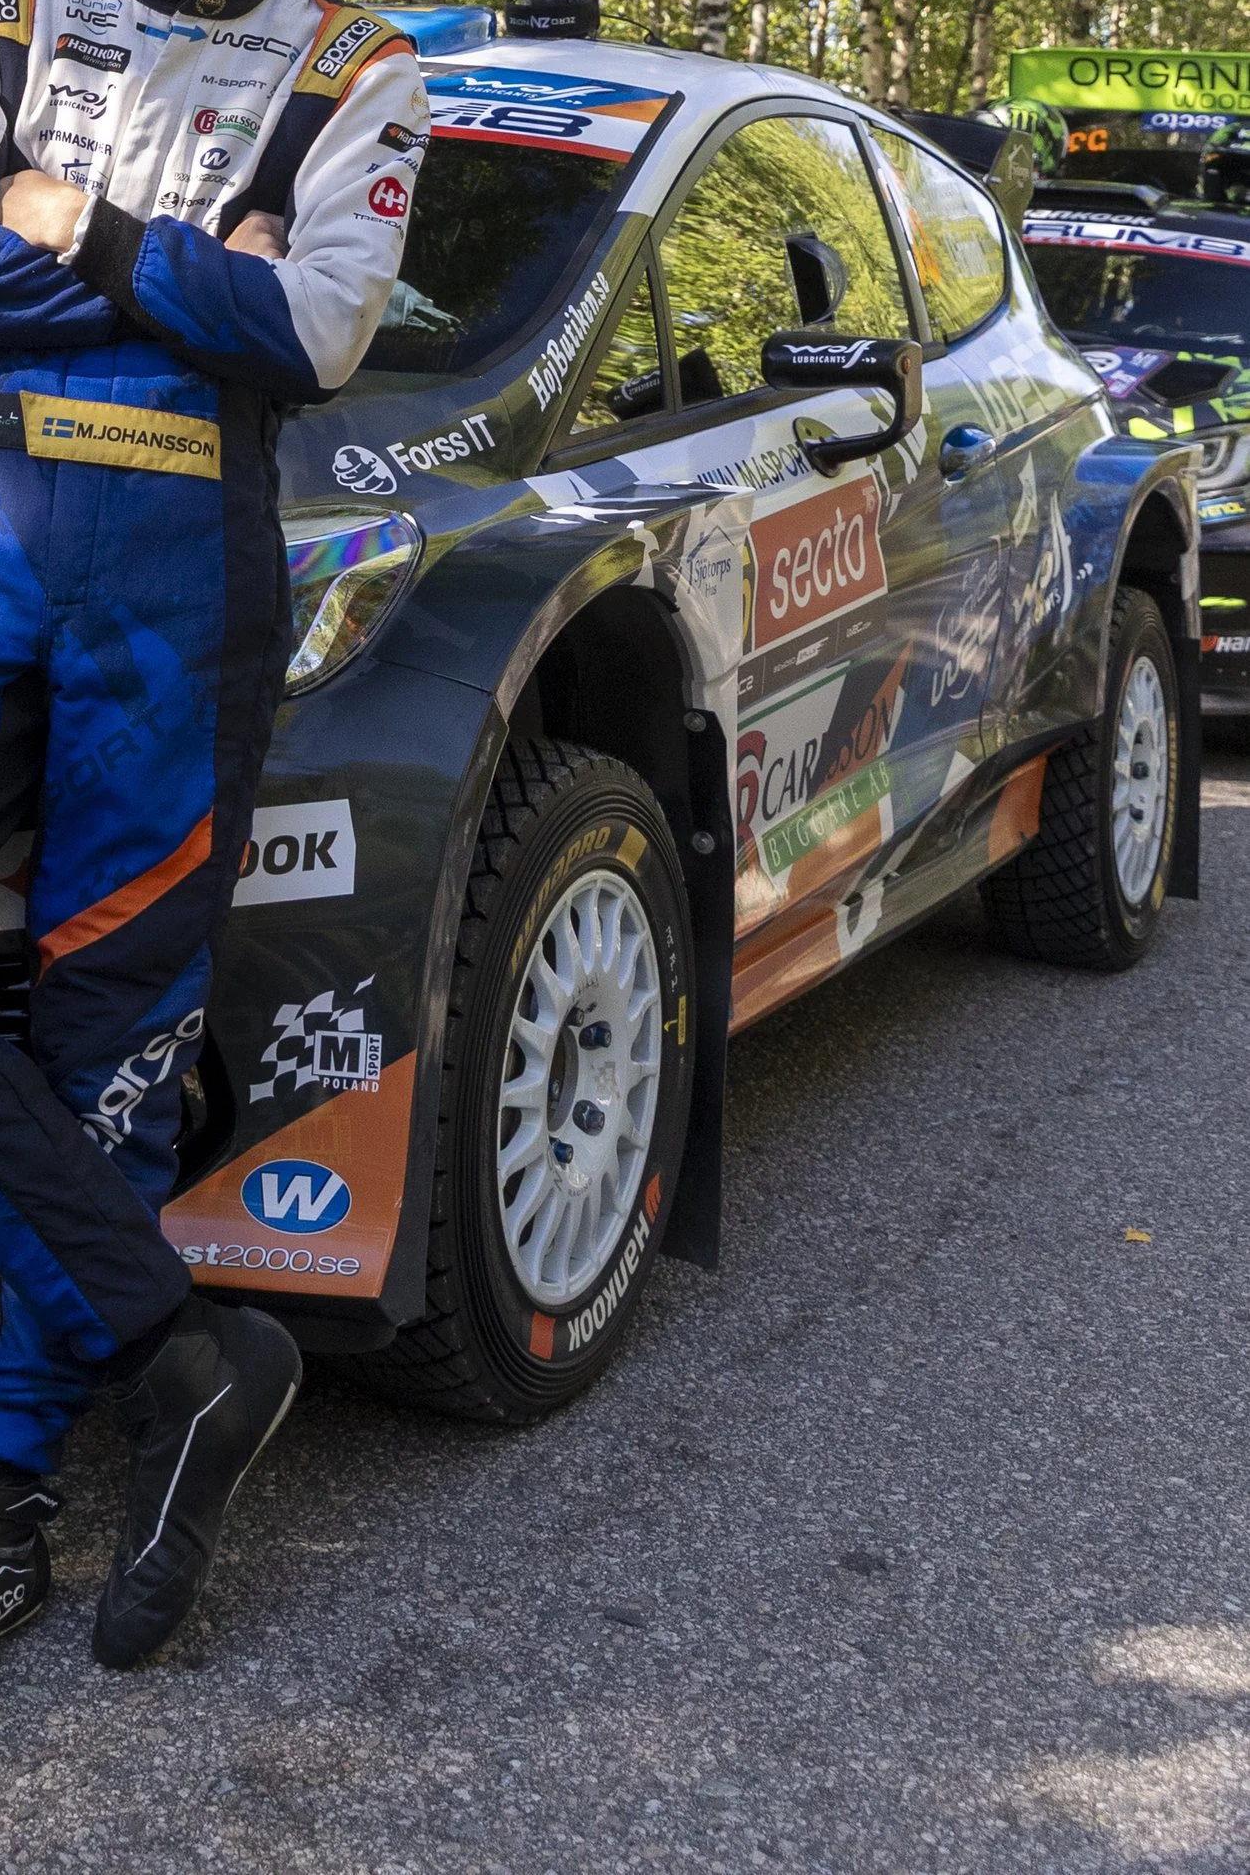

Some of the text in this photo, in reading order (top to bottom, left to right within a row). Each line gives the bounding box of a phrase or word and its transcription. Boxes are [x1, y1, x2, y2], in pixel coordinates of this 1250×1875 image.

[317, 19, 380, 78] sparco
[201, 74, 267, 91] M-SPORT
[49, 98, 95, 115] LUBRICANTS
[1151, 112, 1228, 130] secto
[181, 197, 206, 209] Forss
[792, 355, 846, 365] LUBRICANTS
[76, 422, 216, 459] M.JOHANSSON
[386, 413, 496, 477] Forss IT
[770, 506, 866, 619] secto
[767, 760, 891, 867] BYGGARE AB
[367, 1036, 381, 1078] SPORT
[322, 1076, 380, 1094] POLAND
[261, 1172, 345, 1222] W
[175, 1242, 361, 1277] st2000.se
